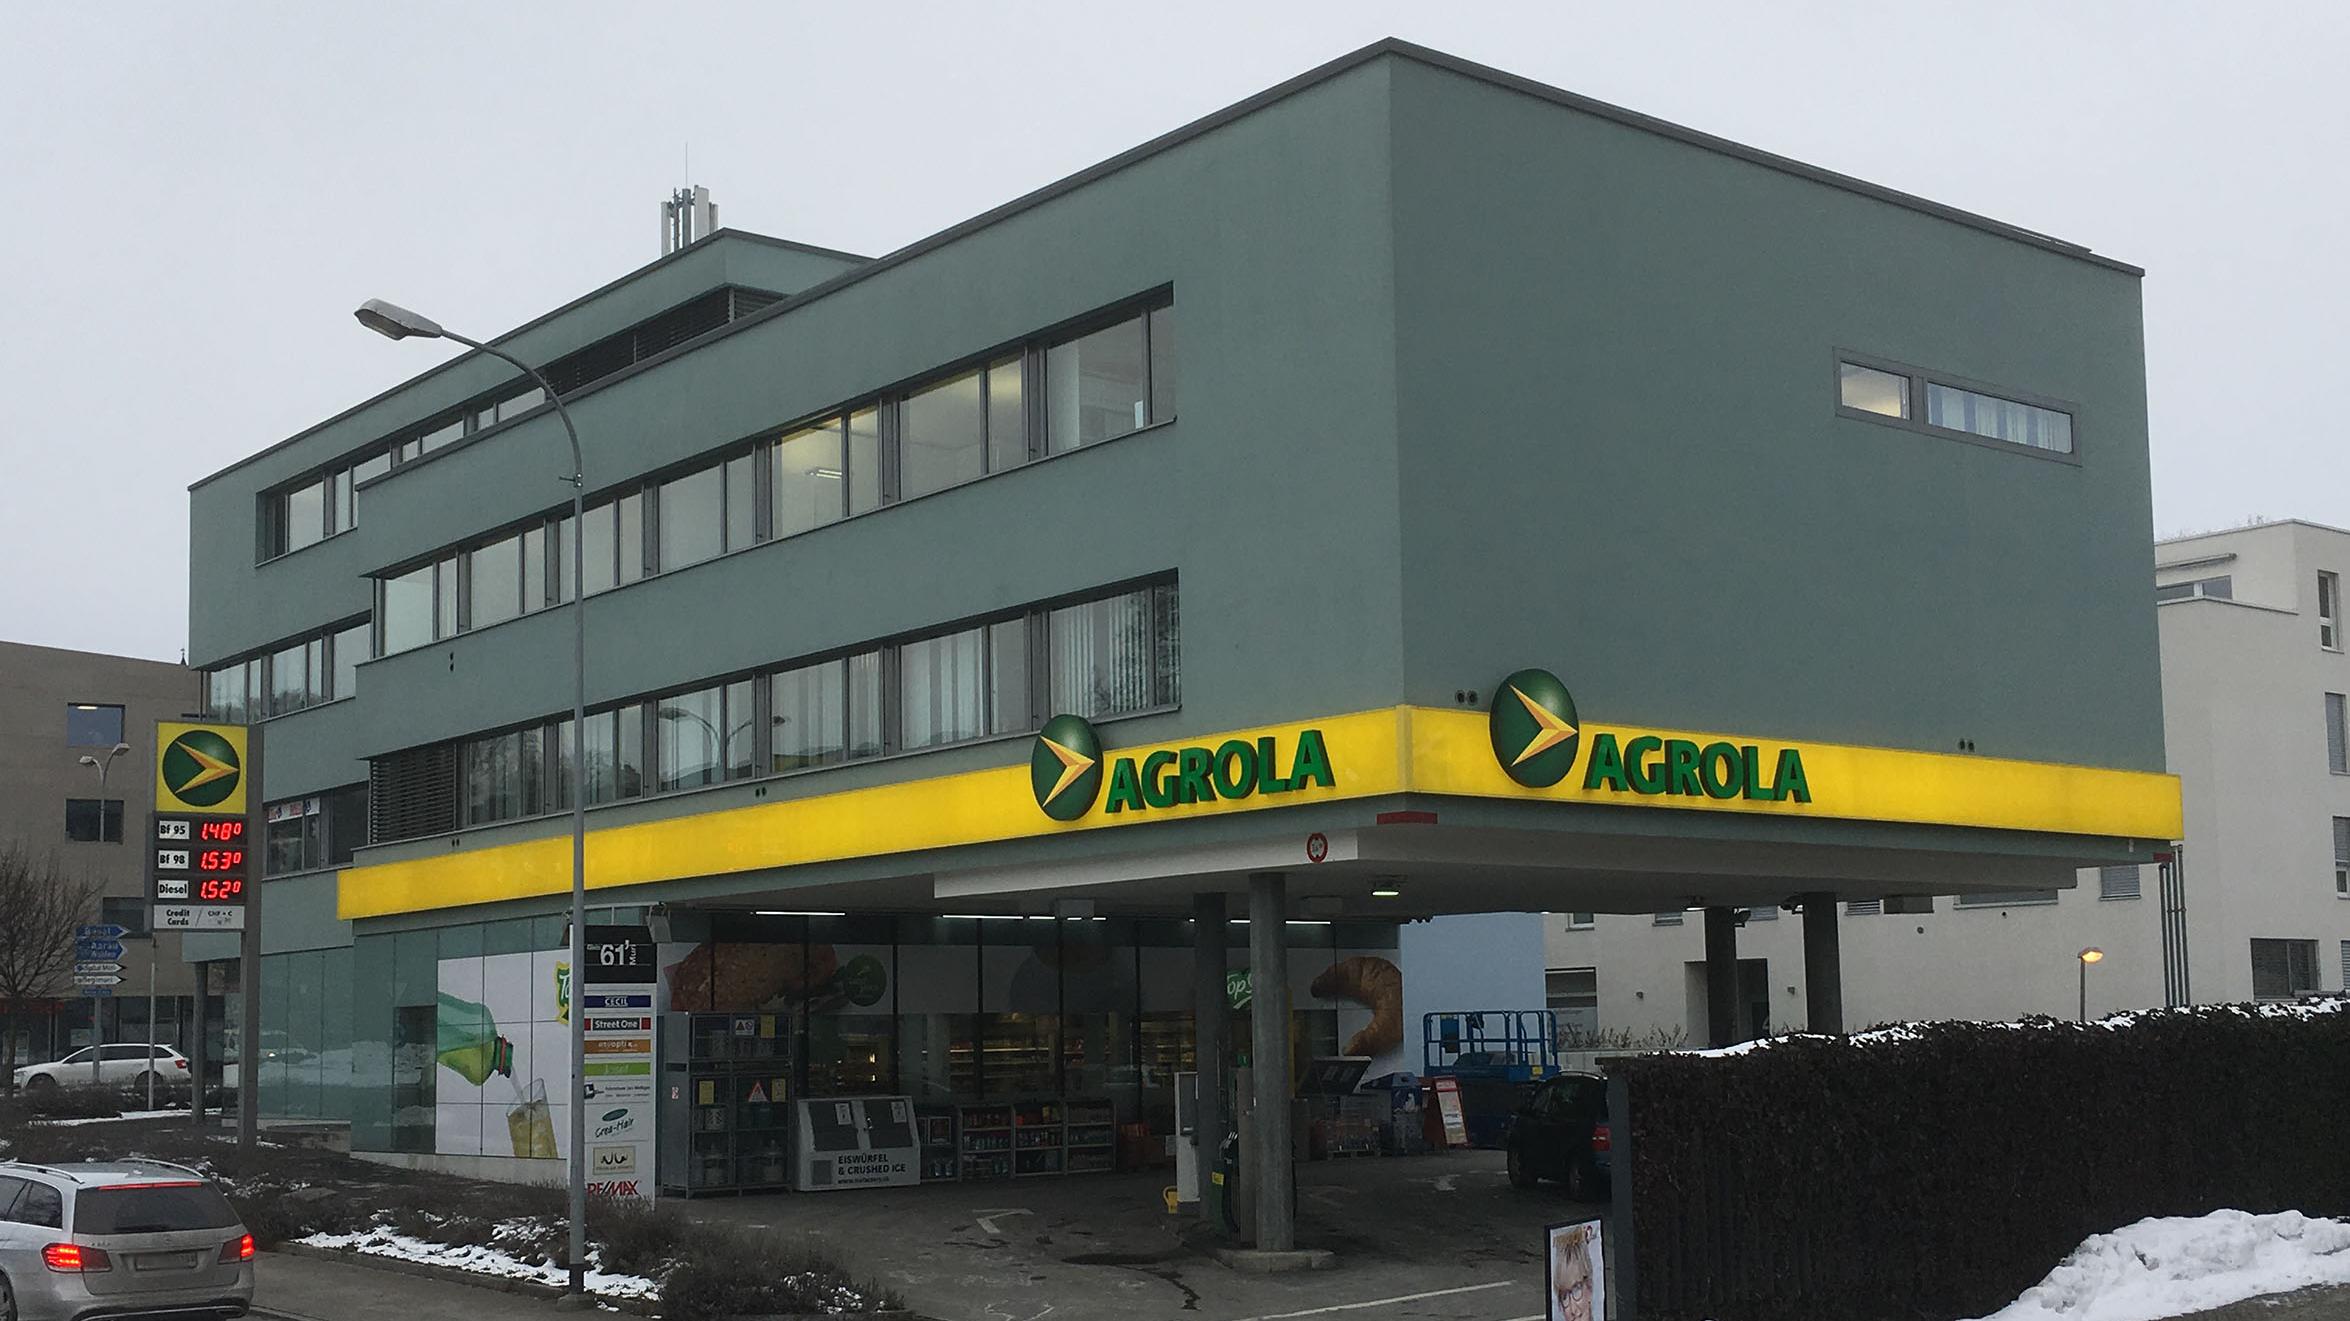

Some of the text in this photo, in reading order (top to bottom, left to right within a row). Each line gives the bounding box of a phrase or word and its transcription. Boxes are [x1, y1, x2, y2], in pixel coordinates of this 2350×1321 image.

[1105, 729, 1336, 814] AGROLA
[1582, 733, 1812, 803] AGROLA
[174, 825, 186, 835] 95
[173, 854, 185, 865] 98
[159, 883, 188, 894] Diesel
[166, 909, 190, 917] Credit
[167, 918, 189, 926] Cards
[604, 997, 629, 1007] CECIL
[594, 1019, 638, 1029] Street One
[838, 1152, 889, 1164] EISWÜRFEL
[838, 1163, 907, 1176] & CRUSHED ICE
